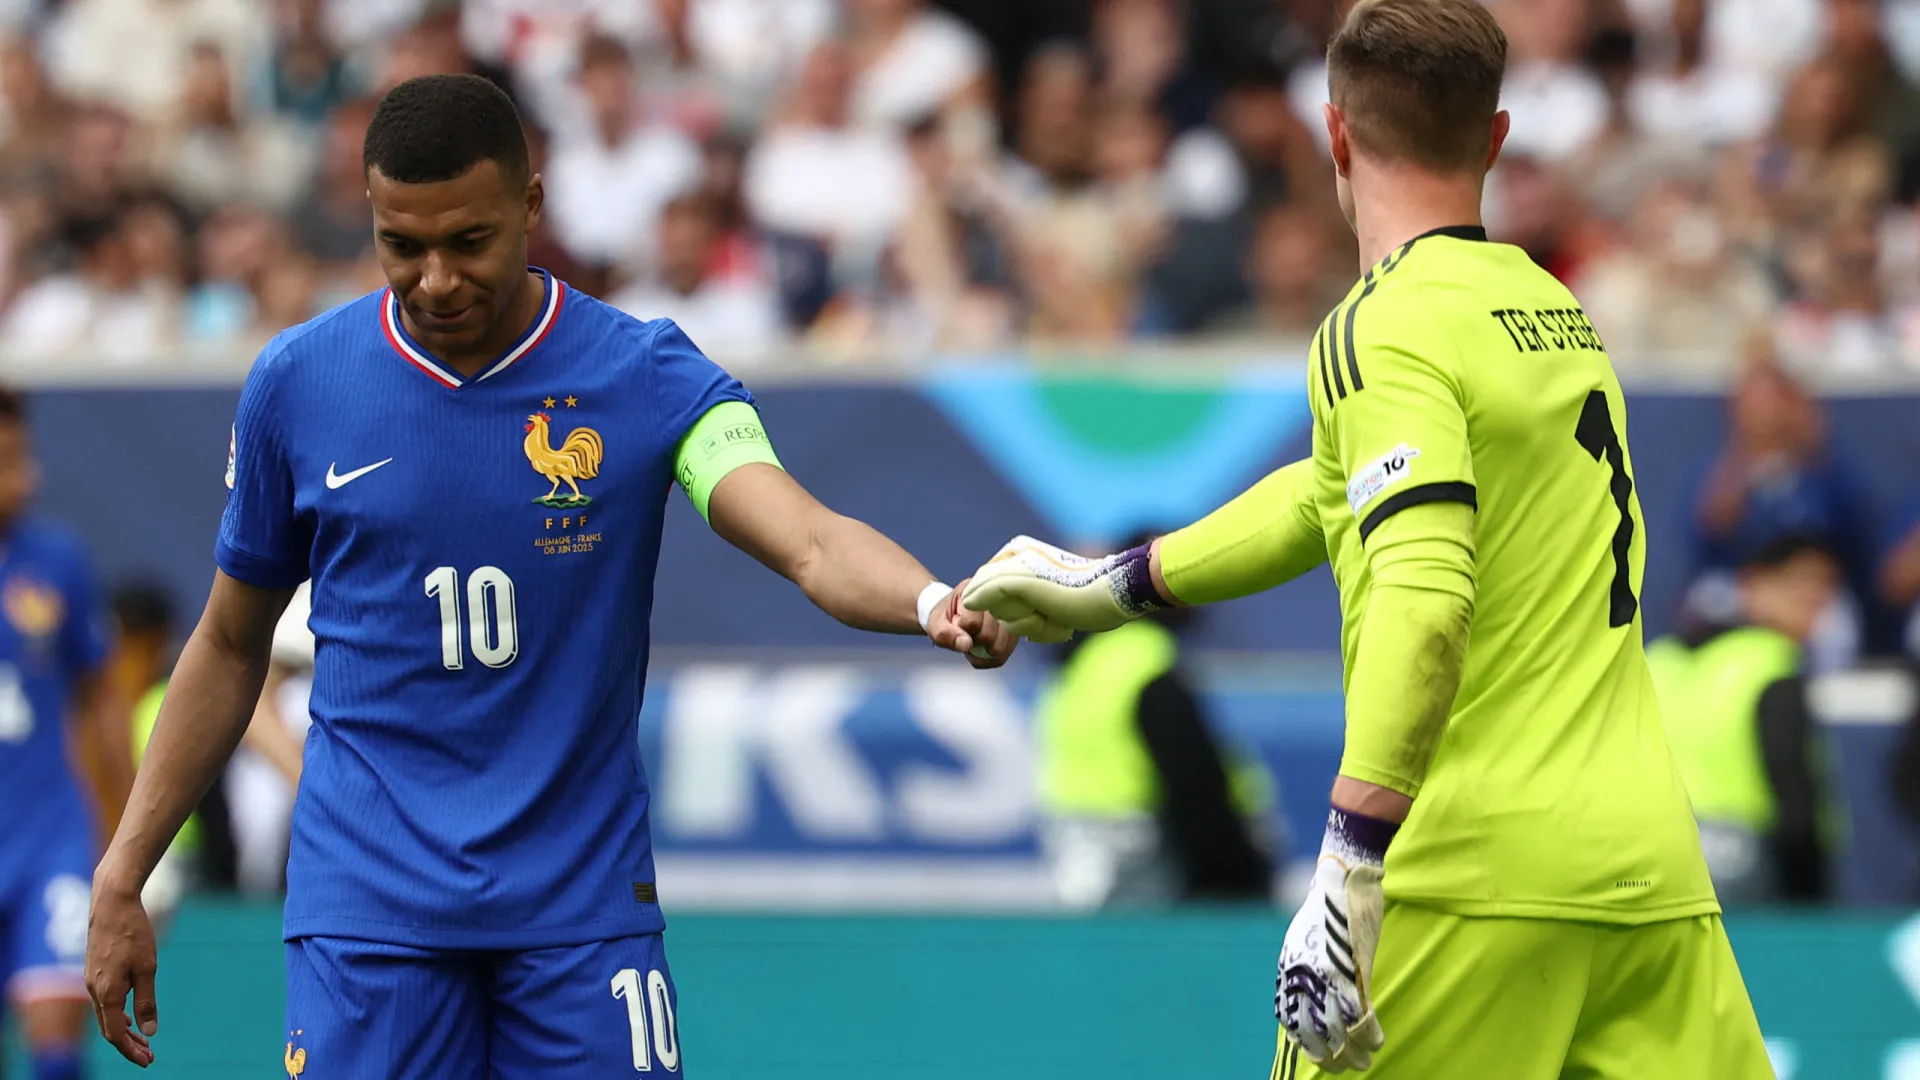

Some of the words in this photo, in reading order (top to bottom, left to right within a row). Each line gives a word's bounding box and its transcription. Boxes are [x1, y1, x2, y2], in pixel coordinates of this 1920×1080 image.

[1490, 309, 1549, 352] TER
[1383, 455, 1405, 476] 10
[1574, 390, 1637, 628] 1
[534, 536, 571, 546] ALLEMAGNE
[577, 533, 602, 543] FRANCE
[558, 545, 571, 554] JUIN
[572, 543, 593, 552] 2025
[425, 566, 518, 670] 10
[611, 969, 678, 1072] 10
